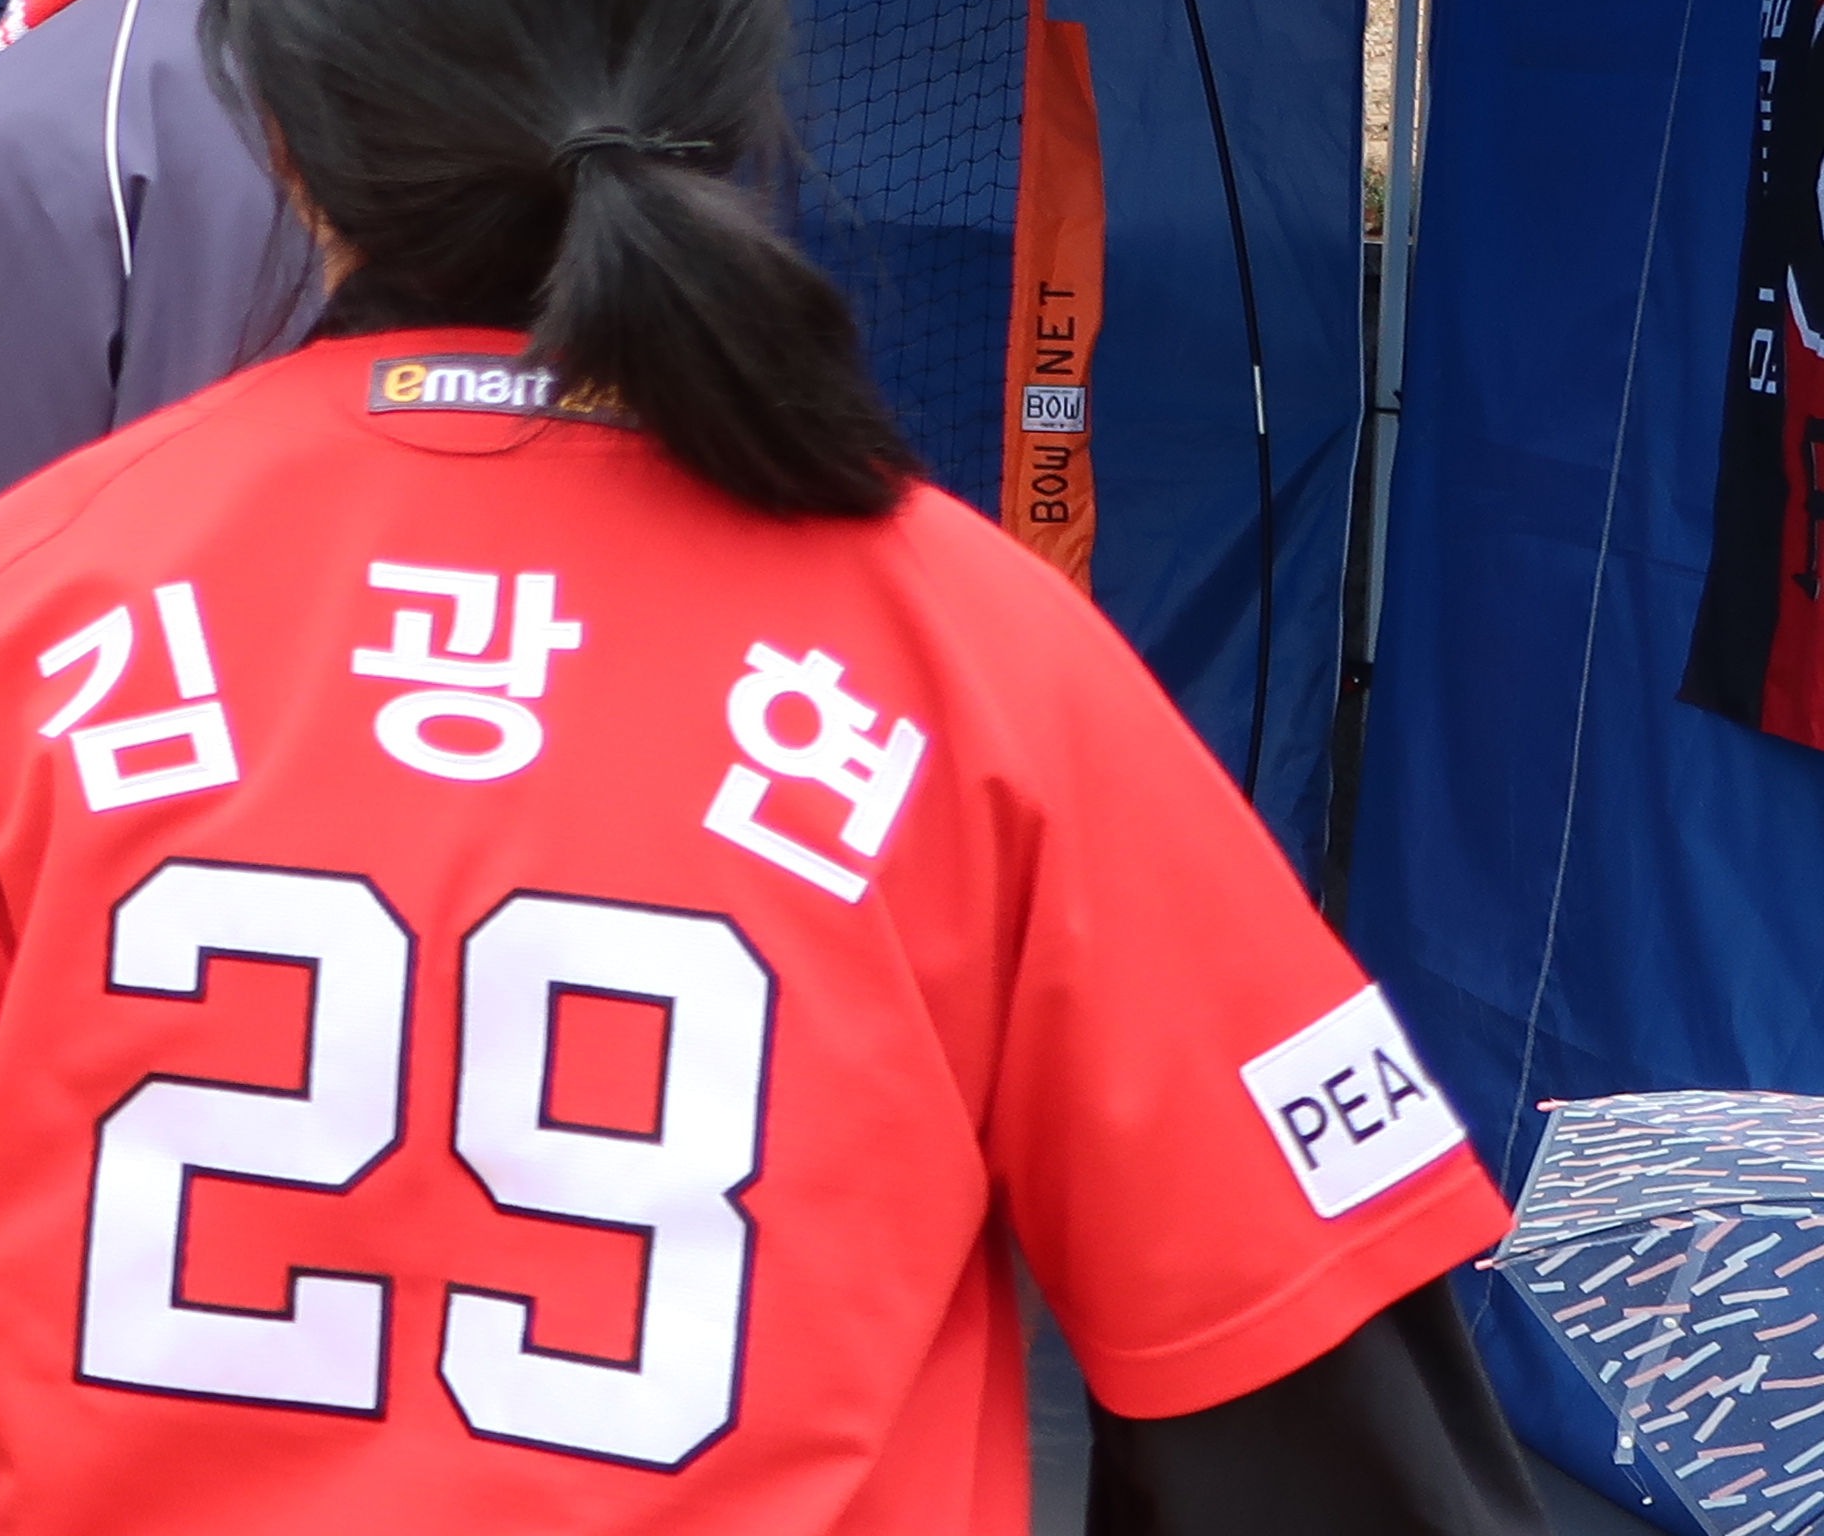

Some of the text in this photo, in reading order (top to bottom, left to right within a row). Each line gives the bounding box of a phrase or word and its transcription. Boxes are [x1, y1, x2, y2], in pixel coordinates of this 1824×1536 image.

[1037, 280, 1076, 376] NET
[1028, 395, 1080, 420] BOW
[1031, 445, 1070, 524] BOW
[1279, 1047, 1428, 1171] PEA
[74, 856, 777, 1475] 29
